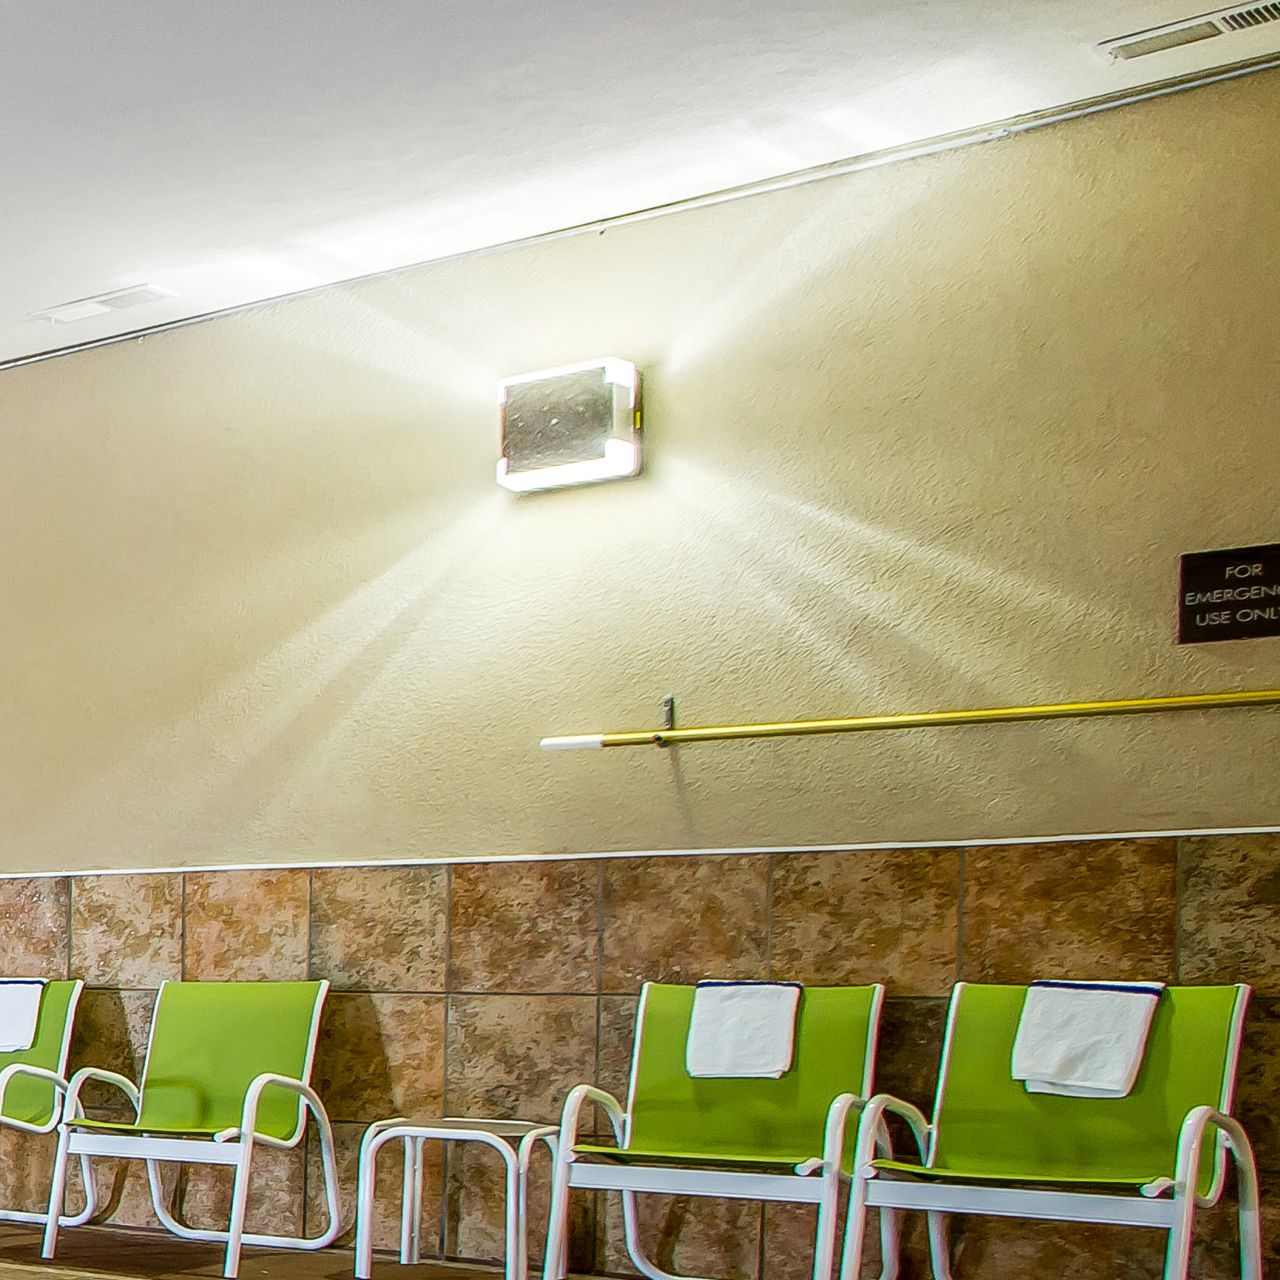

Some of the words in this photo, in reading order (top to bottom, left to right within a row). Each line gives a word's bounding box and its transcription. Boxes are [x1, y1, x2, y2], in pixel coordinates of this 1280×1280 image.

[1225, 563, 1263, 579] FOR
[1185, 585, 1280, 606] EMERGEN
[1196, 611, 1232, 627] USE
[1236, 607, 1280, 622] ONL
